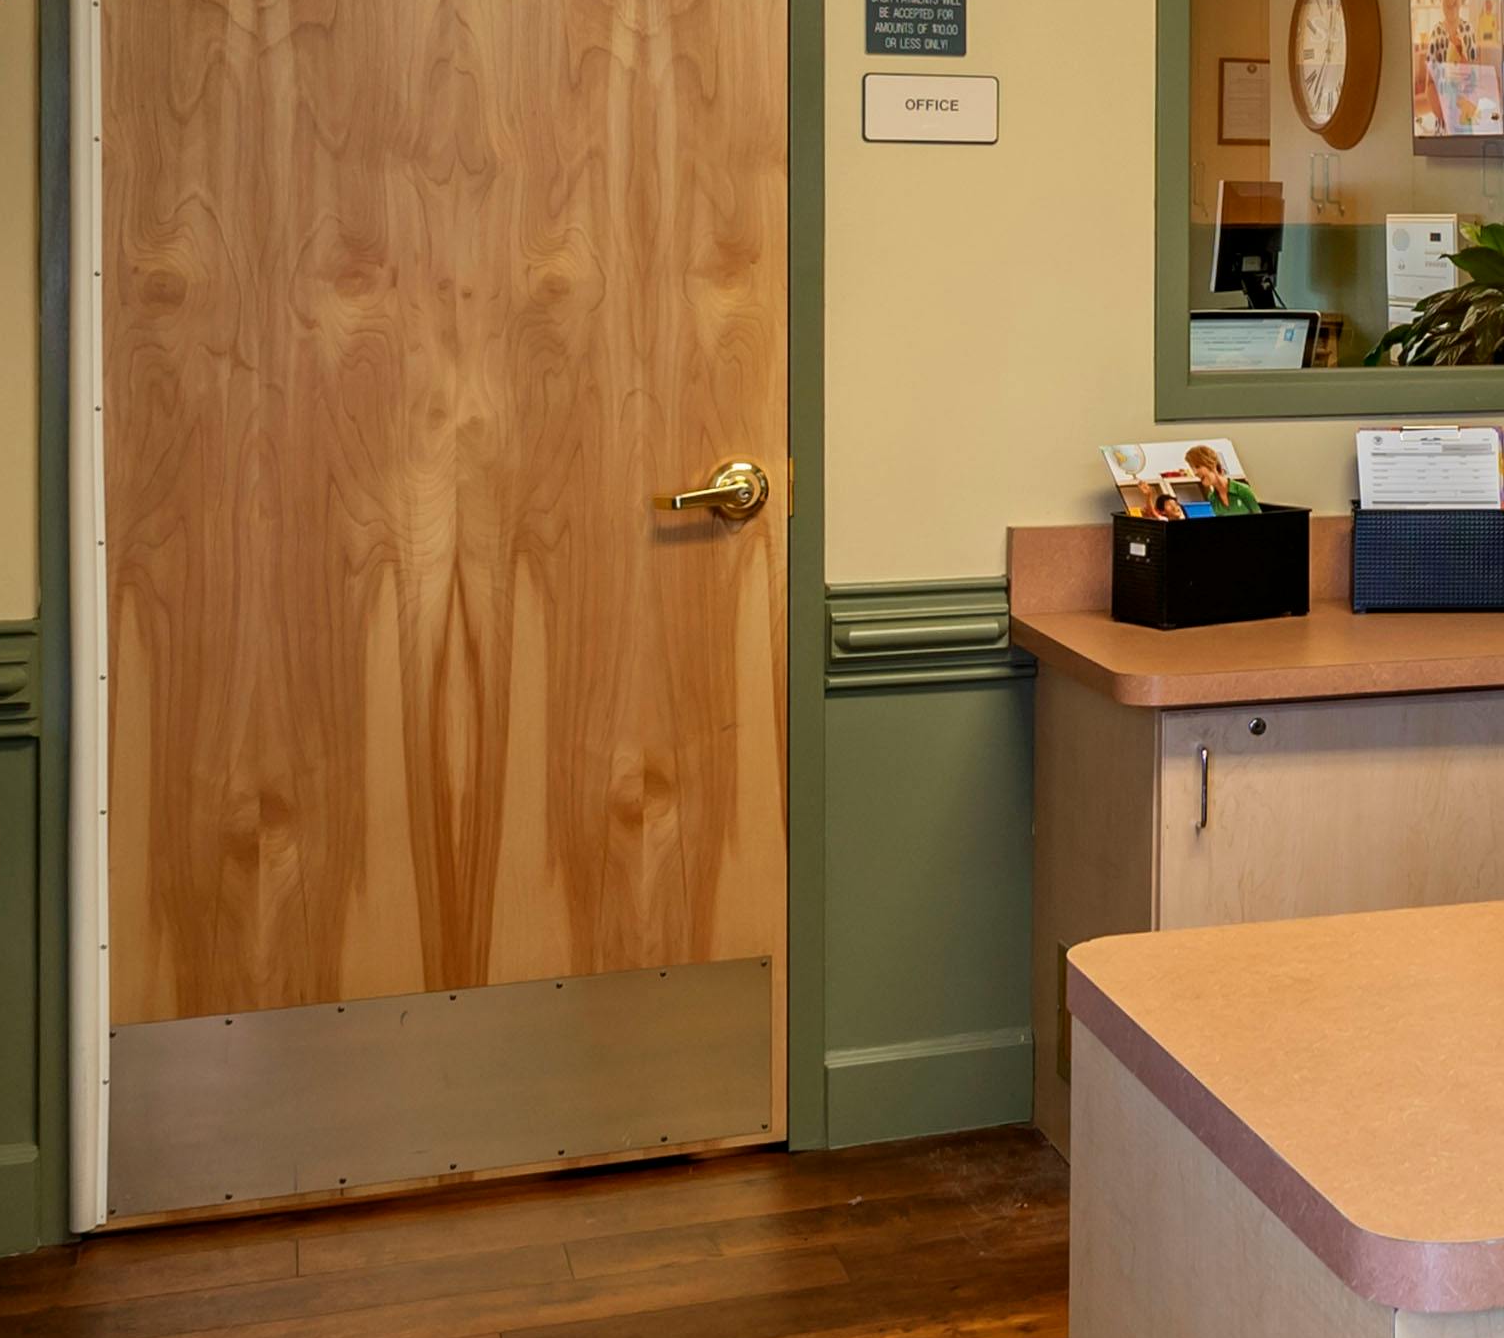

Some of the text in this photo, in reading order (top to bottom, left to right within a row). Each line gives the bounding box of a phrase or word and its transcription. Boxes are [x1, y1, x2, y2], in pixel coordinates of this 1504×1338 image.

[879, 7, 954, 20] BE ACCEPTED FOR
[875, 22, 958, 35] AMOUNTS OF $10.00
[885, 37, 949, 50] OR LESS ONLY!
[905, 98, 959, 112] OFFICE
